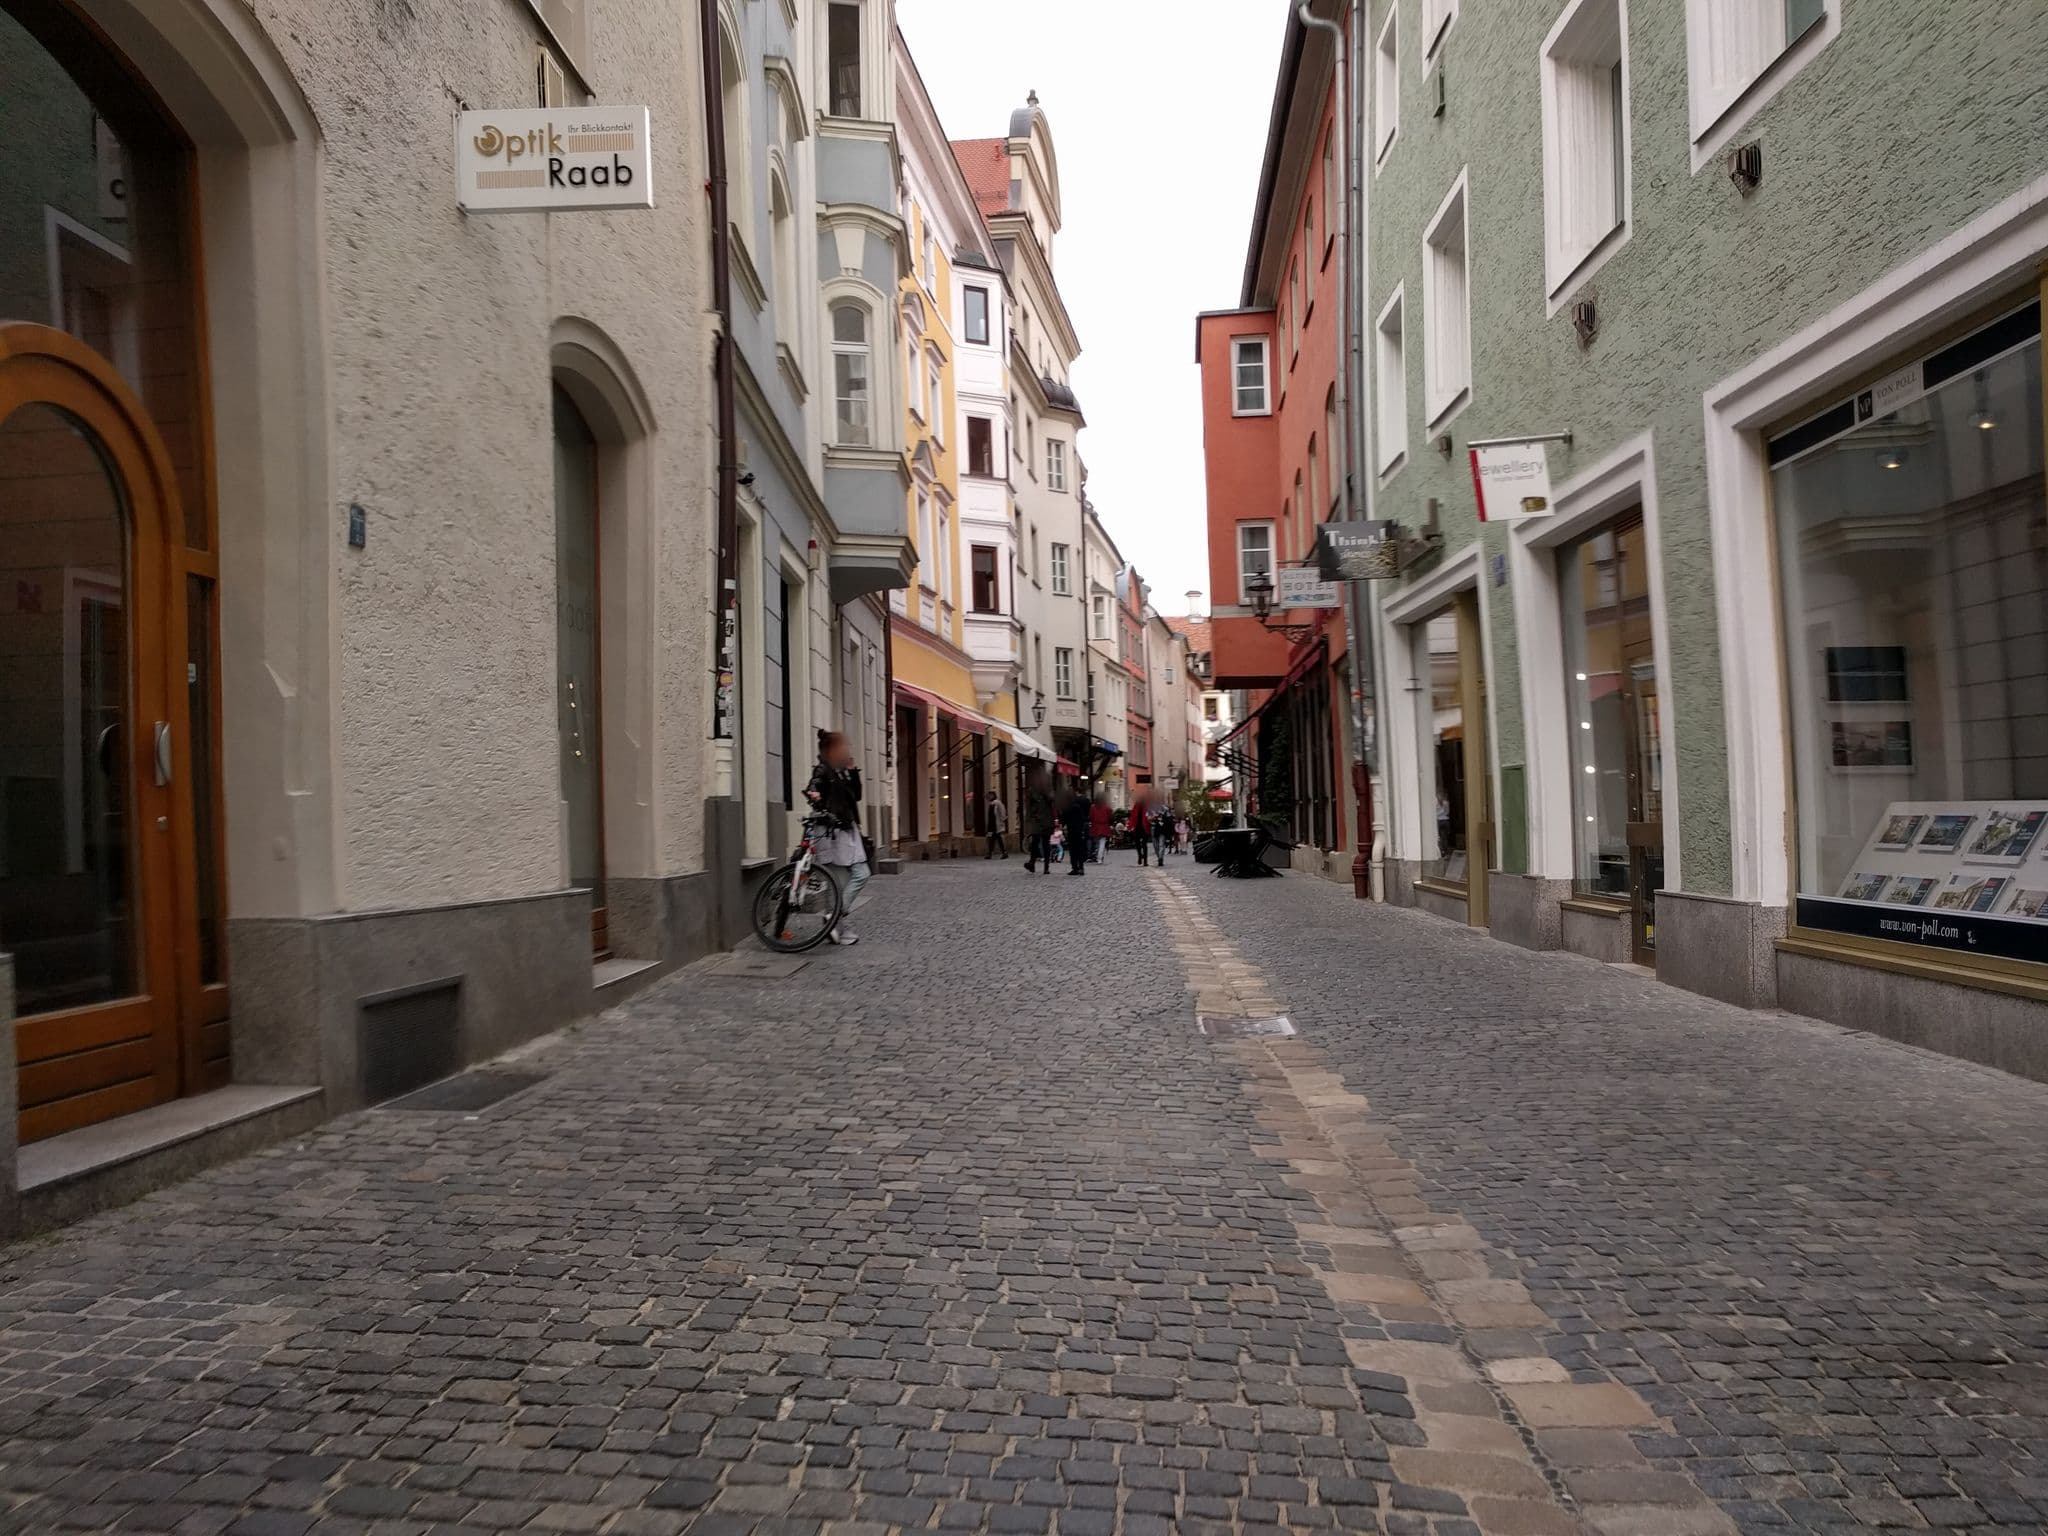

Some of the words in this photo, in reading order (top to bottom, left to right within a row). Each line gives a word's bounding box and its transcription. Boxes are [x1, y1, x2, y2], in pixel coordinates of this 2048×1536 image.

[567, 125, 579, 133] Ihr
[581, 122, 634, 134] Blickkontakt!
[473, 122, 565, 163] Optik
[548, 153, 633, 187] Raab
[1895, 373, 1918, 391] POLL
[1325, 528, 1387, 547] Think!
[1283, 581, 1334, 591] HOTEL
[1880, 919, 1959, 940] www.von-poll.com
